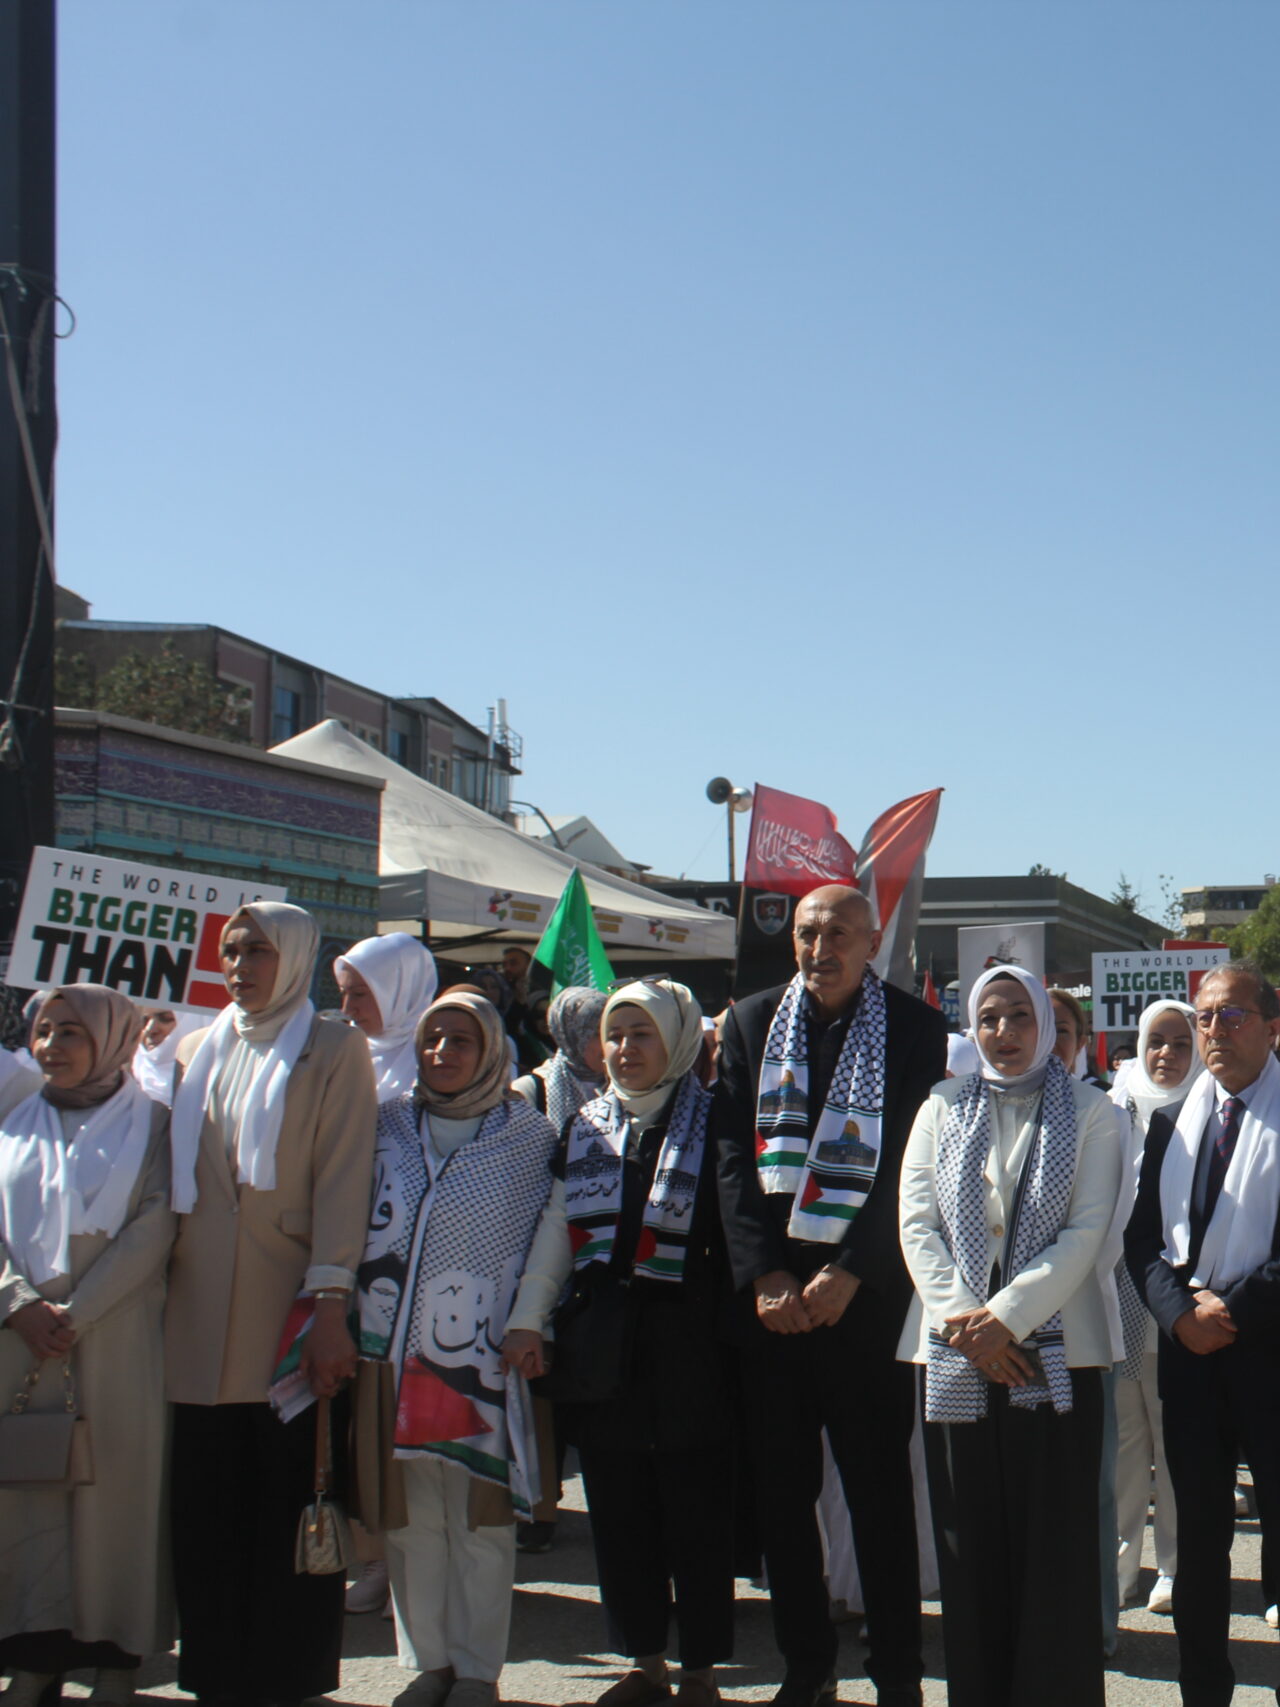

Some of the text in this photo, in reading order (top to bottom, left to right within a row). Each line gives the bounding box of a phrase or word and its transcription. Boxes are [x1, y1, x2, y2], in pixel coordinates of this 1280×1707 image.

[52, 861, 103, 885] THE
[123, 873, 218, 903] WORLD
[47, 887, 197, 945] BIGGER
[32, 925, 194, 1004] THAN
[1103, 955, 1218, 968] THE WORLD IS
[1106, 971, 1187, 992] BIGGER
